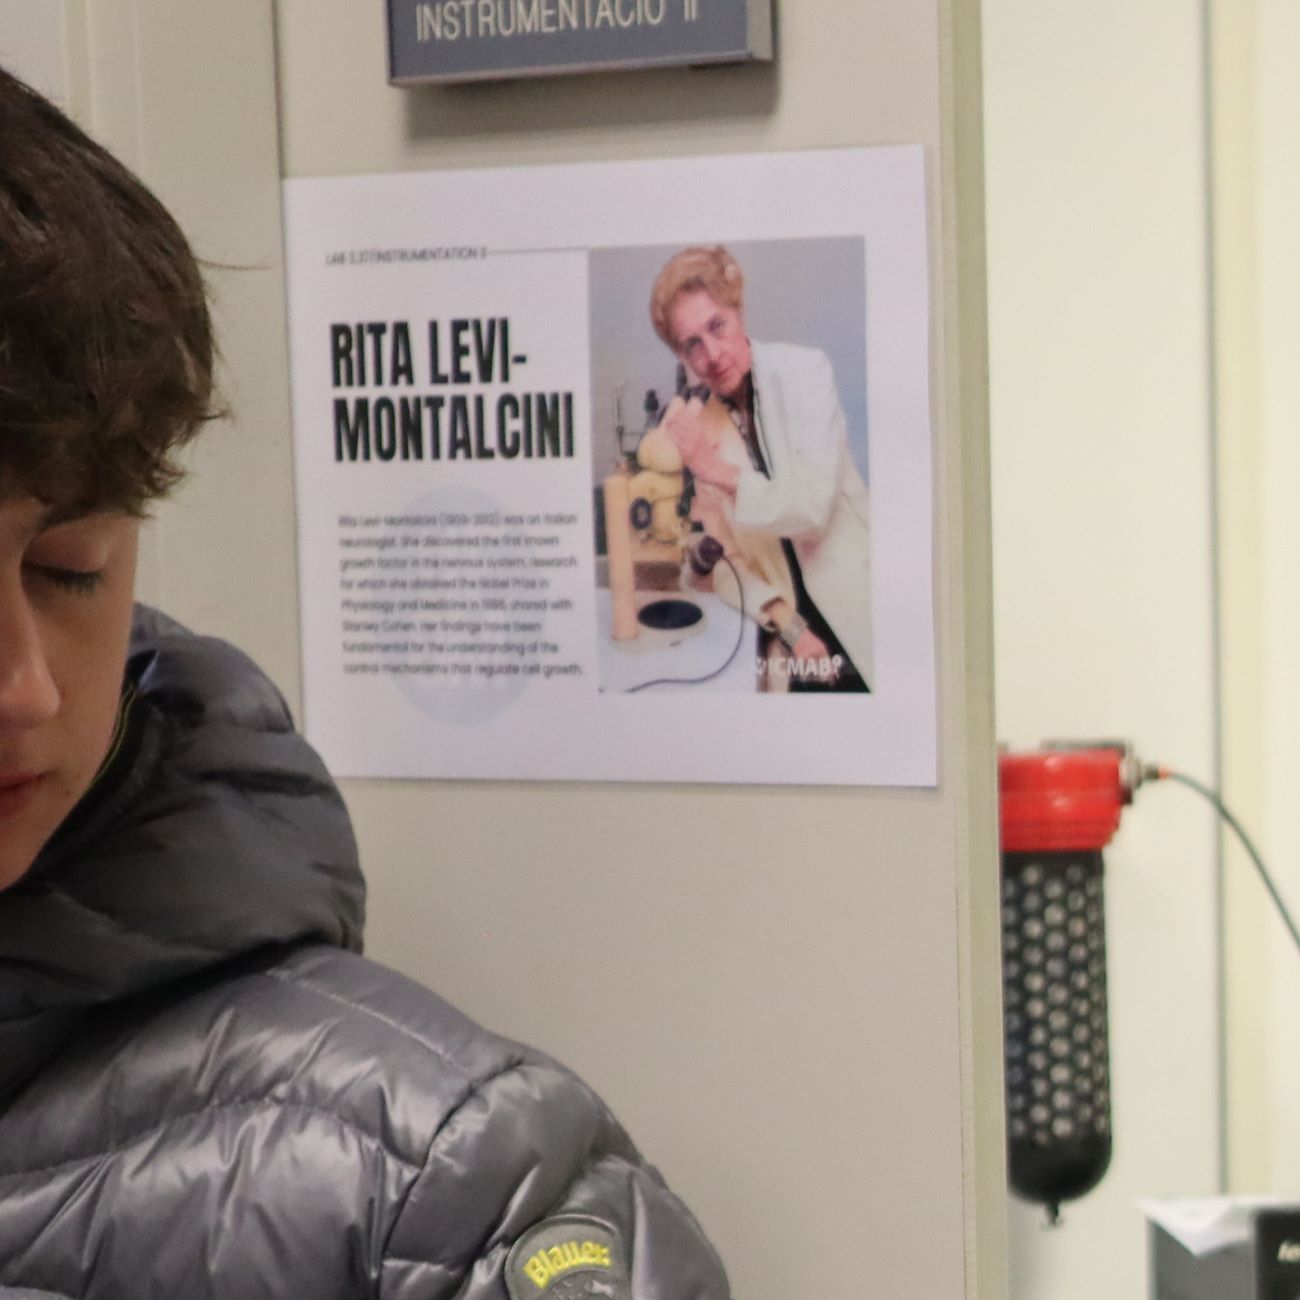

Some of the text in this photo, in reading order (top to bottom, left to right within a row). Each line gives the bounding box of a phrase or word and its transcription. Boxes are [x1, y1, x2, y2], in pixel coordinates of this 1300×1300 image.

[330, 316, 527, 387] RITA LEVI-
[333, 391, 574, 462] MONTALCINI
